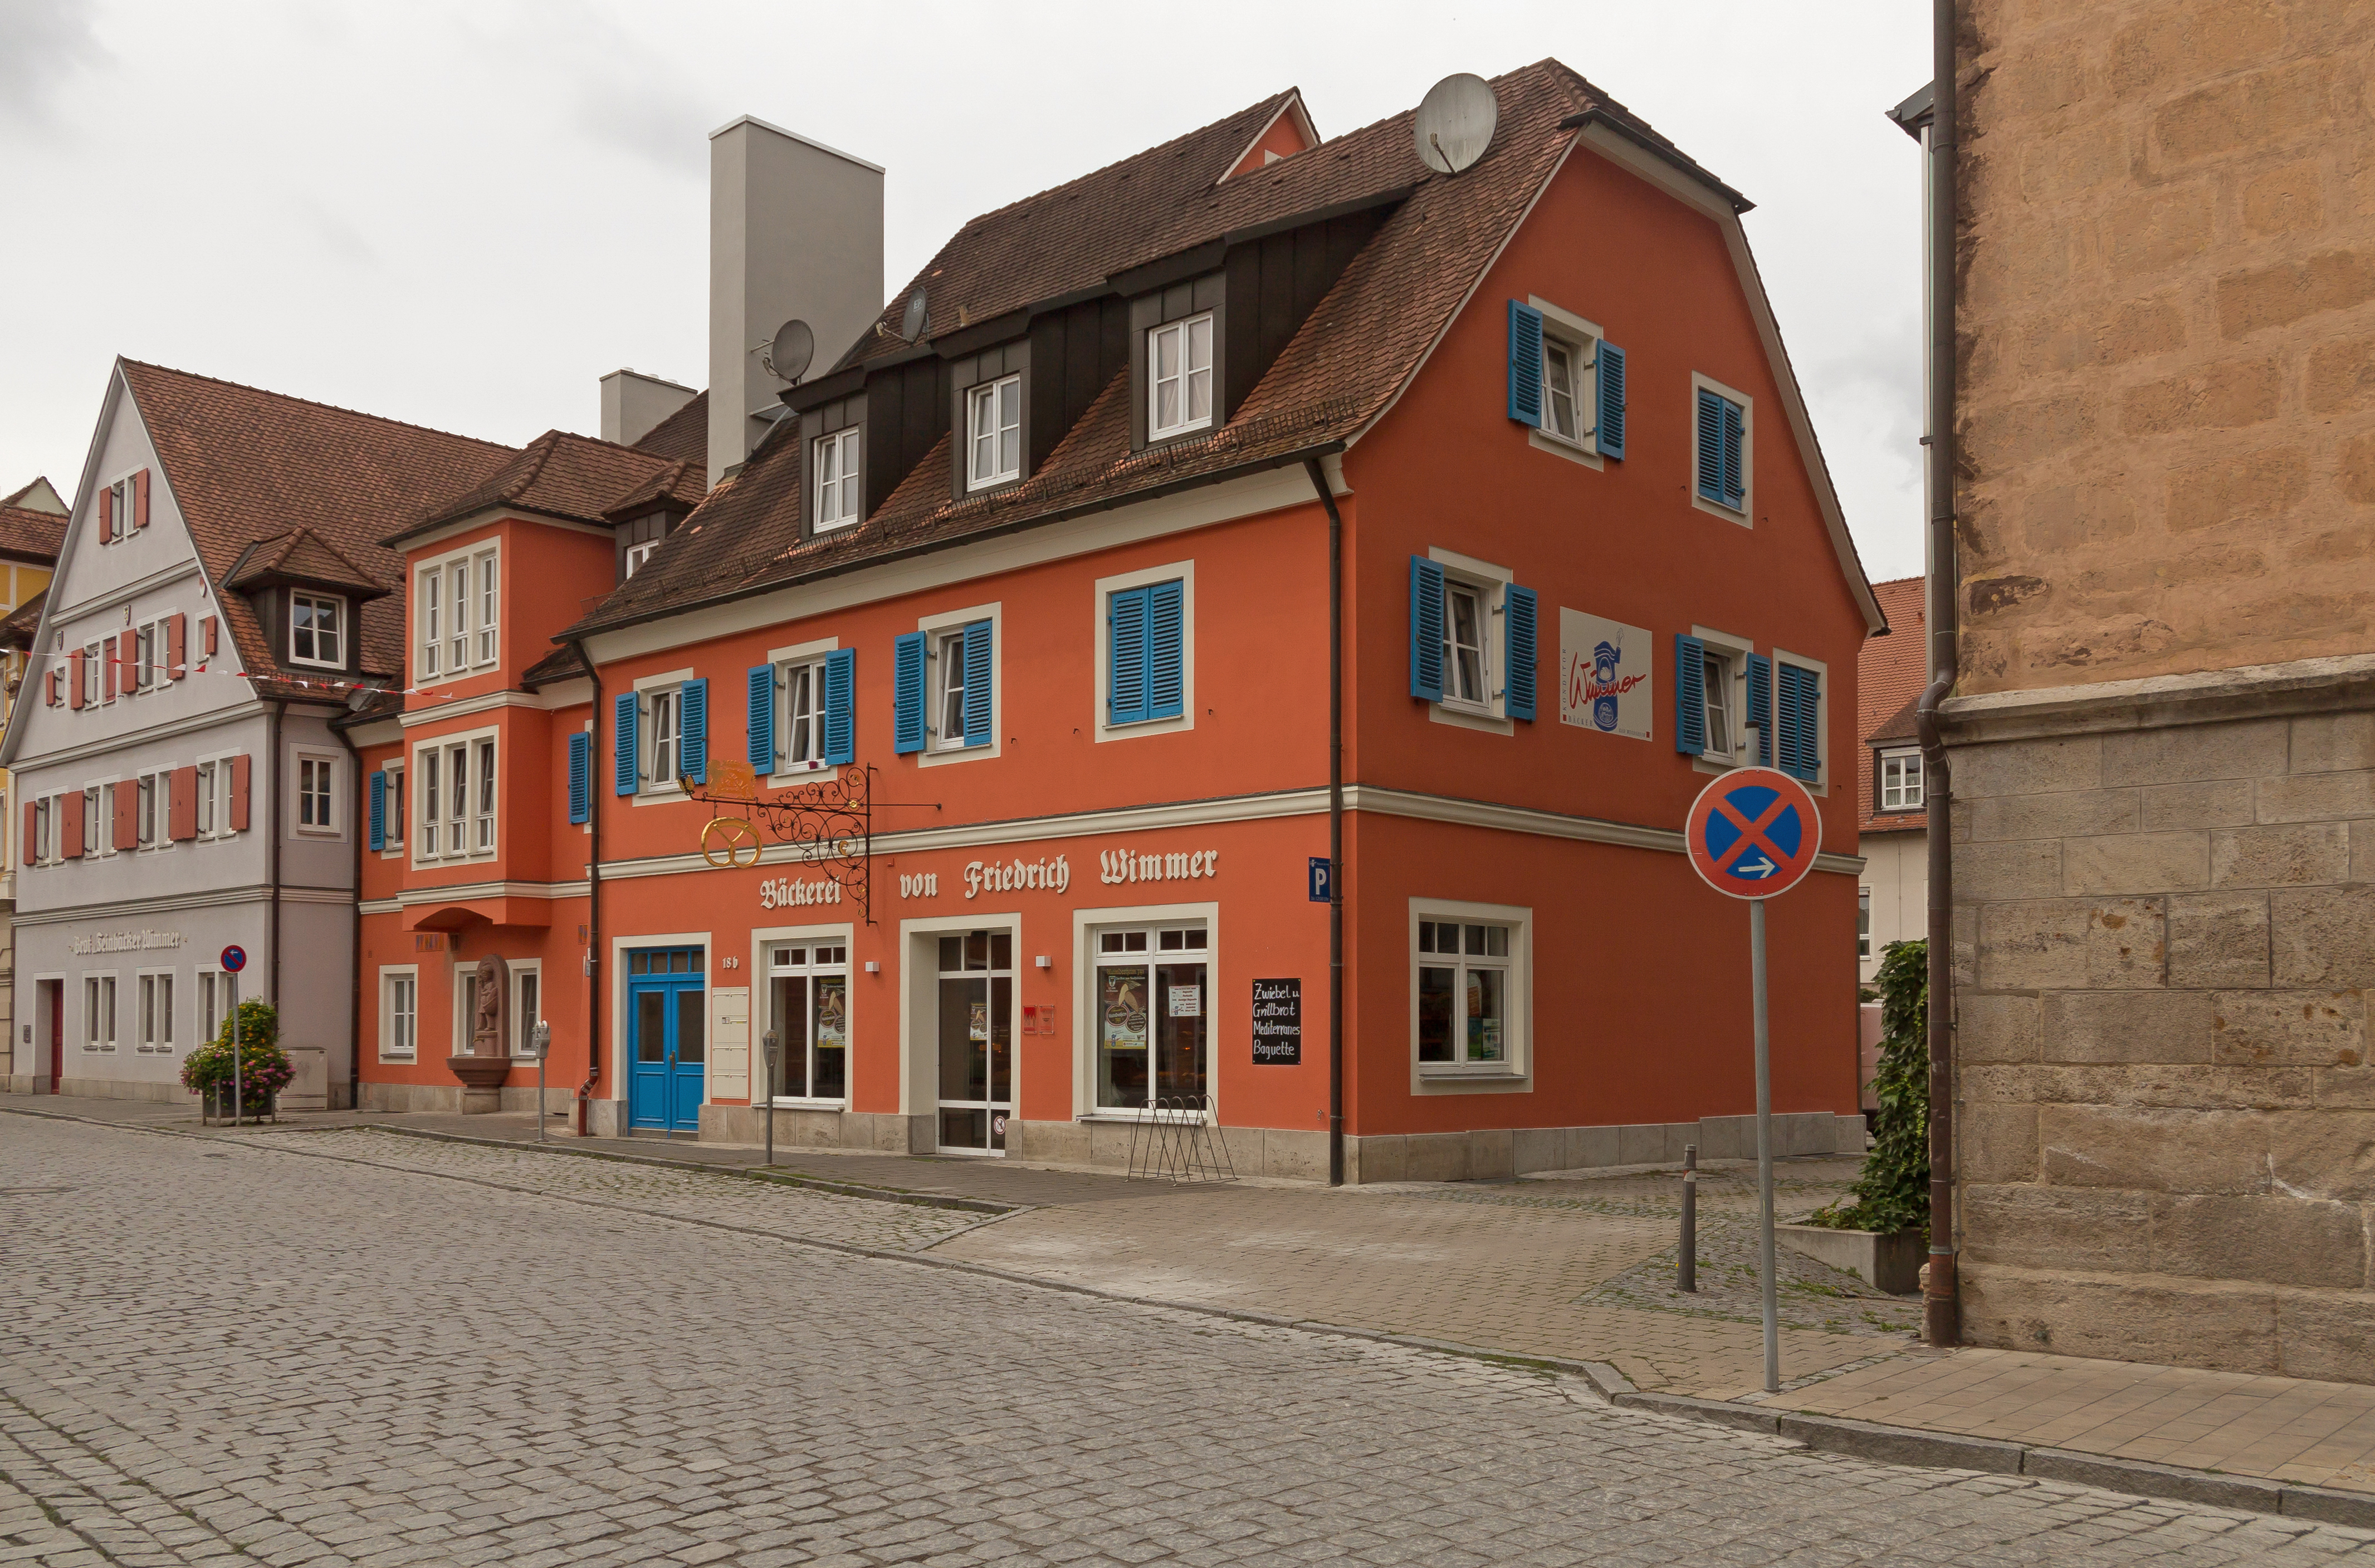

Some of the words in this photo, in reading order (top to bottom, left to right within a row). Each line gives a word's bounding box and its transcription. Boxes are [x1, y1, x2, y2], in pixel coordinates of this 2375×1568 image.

[1568, 715, 1594, 727] BÄCKER
[760, 874, 842, 909] Bäckerei
[900, 873, 939, 899] von
[964, 854, 1071, 899] Friedrich
[1100, 849, 1219, 884] Wimmer
[1315, 868, 1327, 895] P
[141, 928, 180, 949] Wimmer
[1254, 983, 1291, 999] Zwiebel
[1253, 1002, 1296, 1018] Grillbrot
[1253, 1020, 1301, 1035] Mediterranes
[1254, 1040, 1295, 1060] Baguette
